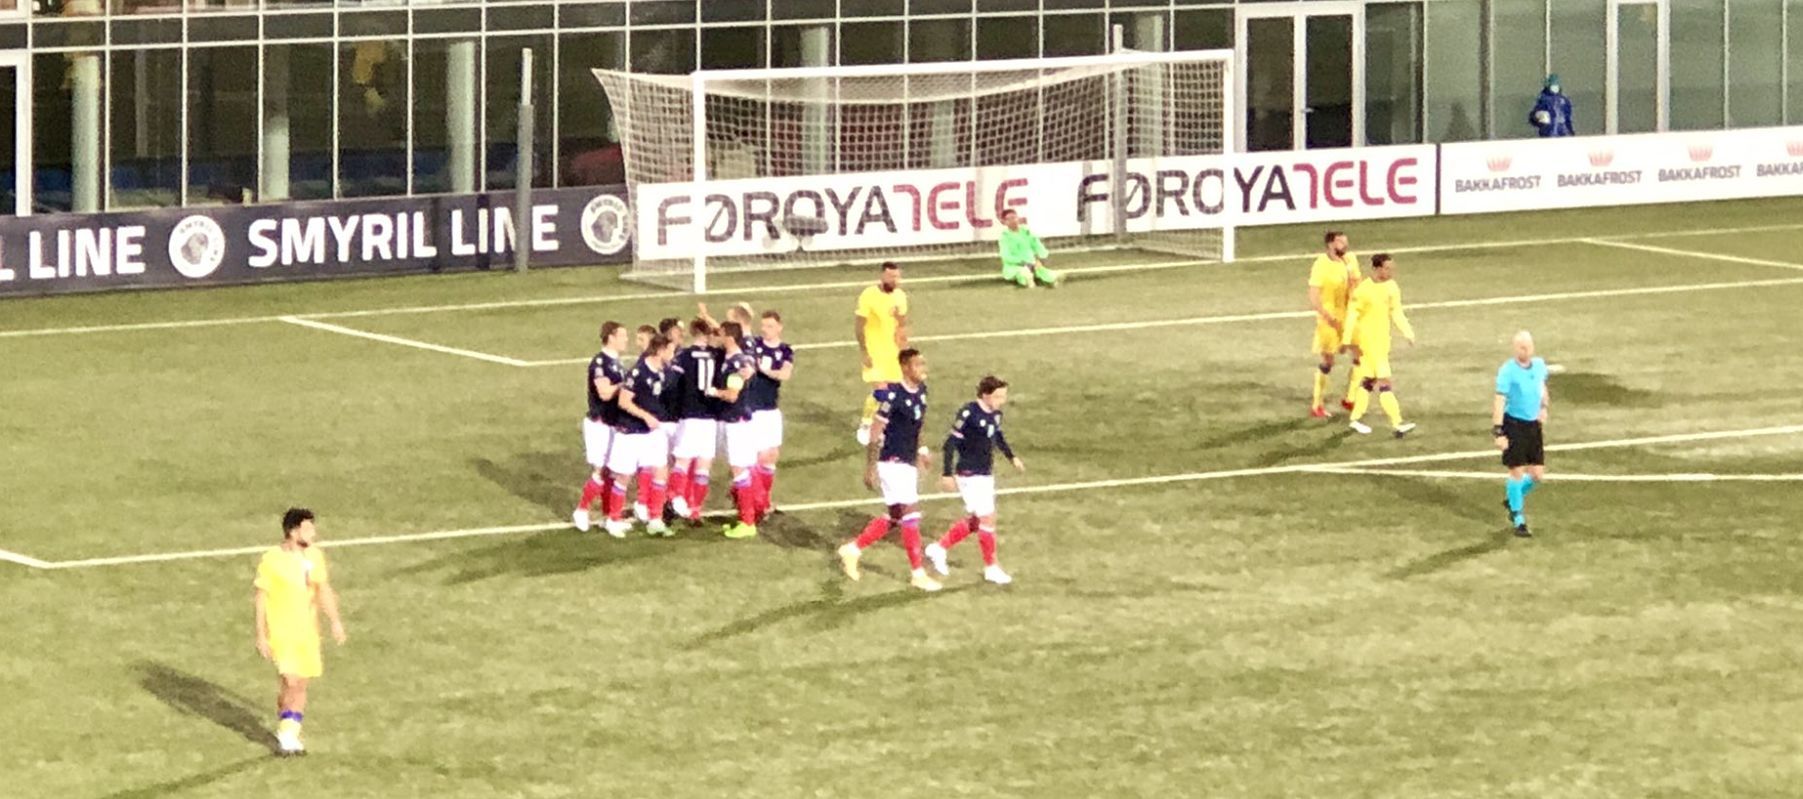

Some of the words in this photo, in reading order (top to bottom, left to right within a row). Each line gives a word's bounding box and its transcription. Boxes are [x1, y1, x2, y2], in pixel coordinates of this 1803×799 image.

[1455, 175, 1542, 192] BAKKAFROST
[1557, 170, 1642, 187] BAKKAFROST
[1657, 165, 1741, 182] BAKKAFROST
[248, 210, 437, 268] SMYRIL
[451, 205, 559, 255] LINE
[29, 225, 146, 279] LINE
[698, 358, 715, 391] 11
